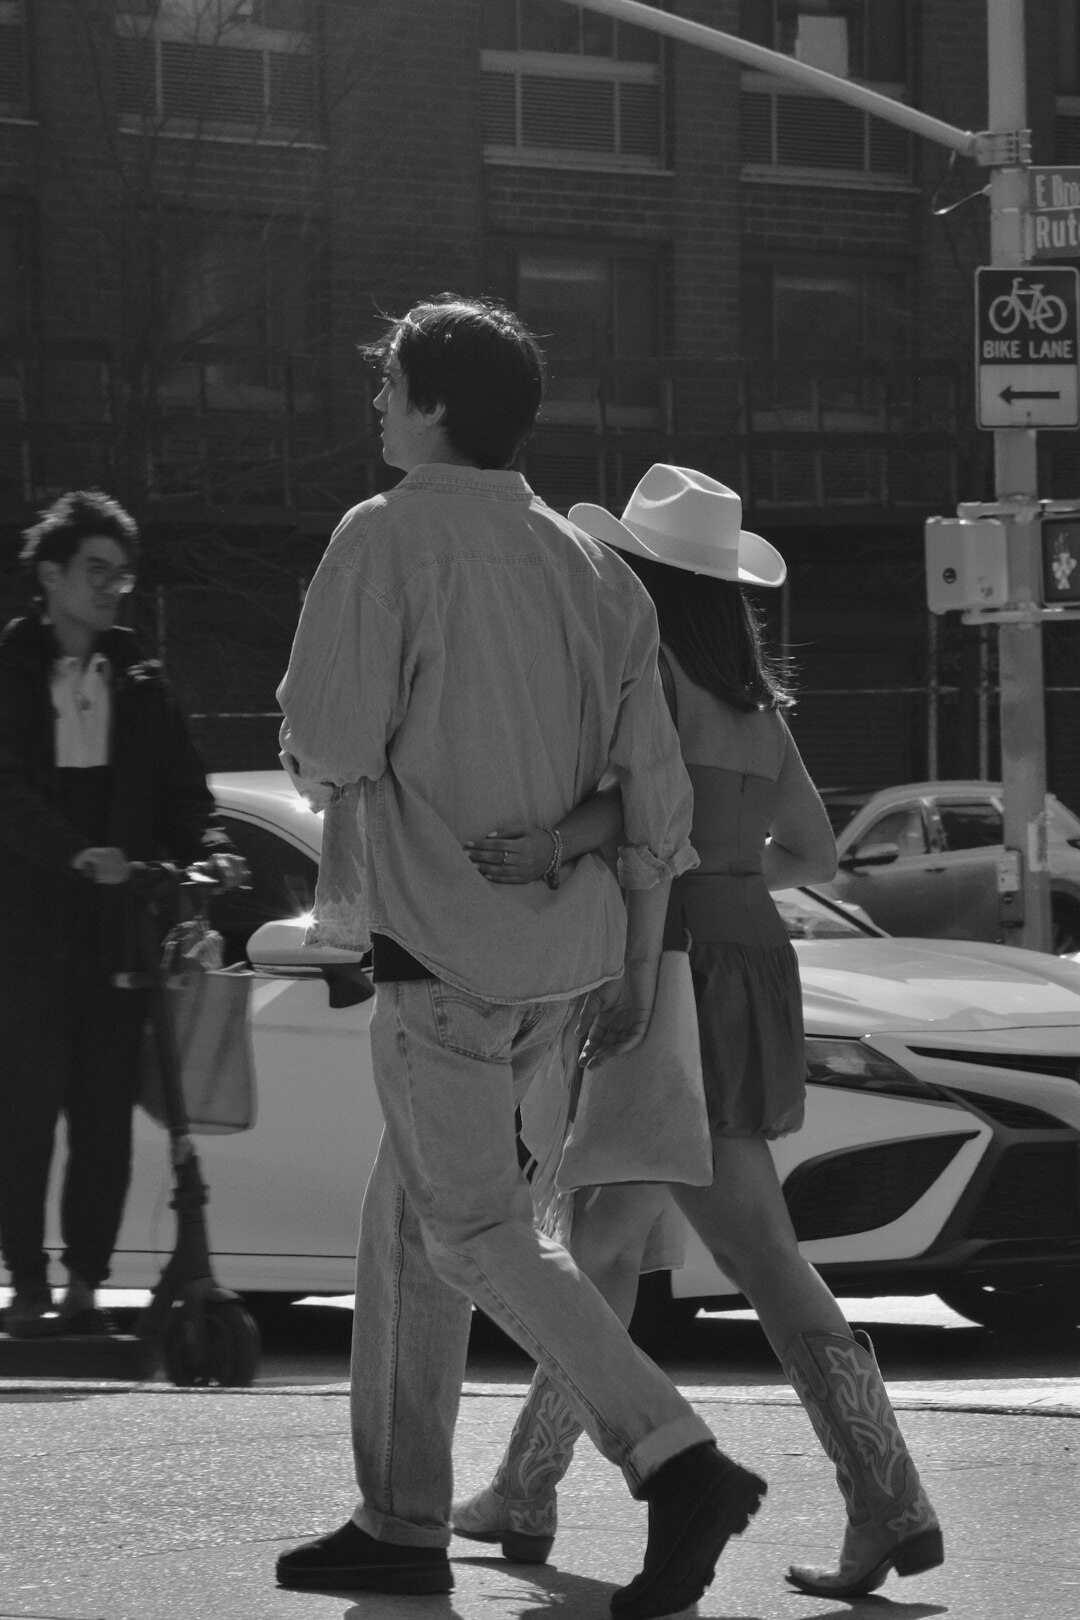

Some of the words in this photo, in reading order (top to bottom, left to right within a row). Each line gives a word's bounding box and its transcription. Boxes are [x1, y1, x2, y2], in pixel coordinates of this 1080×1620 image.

[1036, 174, 1047, 207] E
[1052, 174, 1080, 207] Bro
[1036, 213, 1080, 248] Rut
[983, 340, 1021, 358] BIKE
[1029, 340, 1073, 358] LANE
